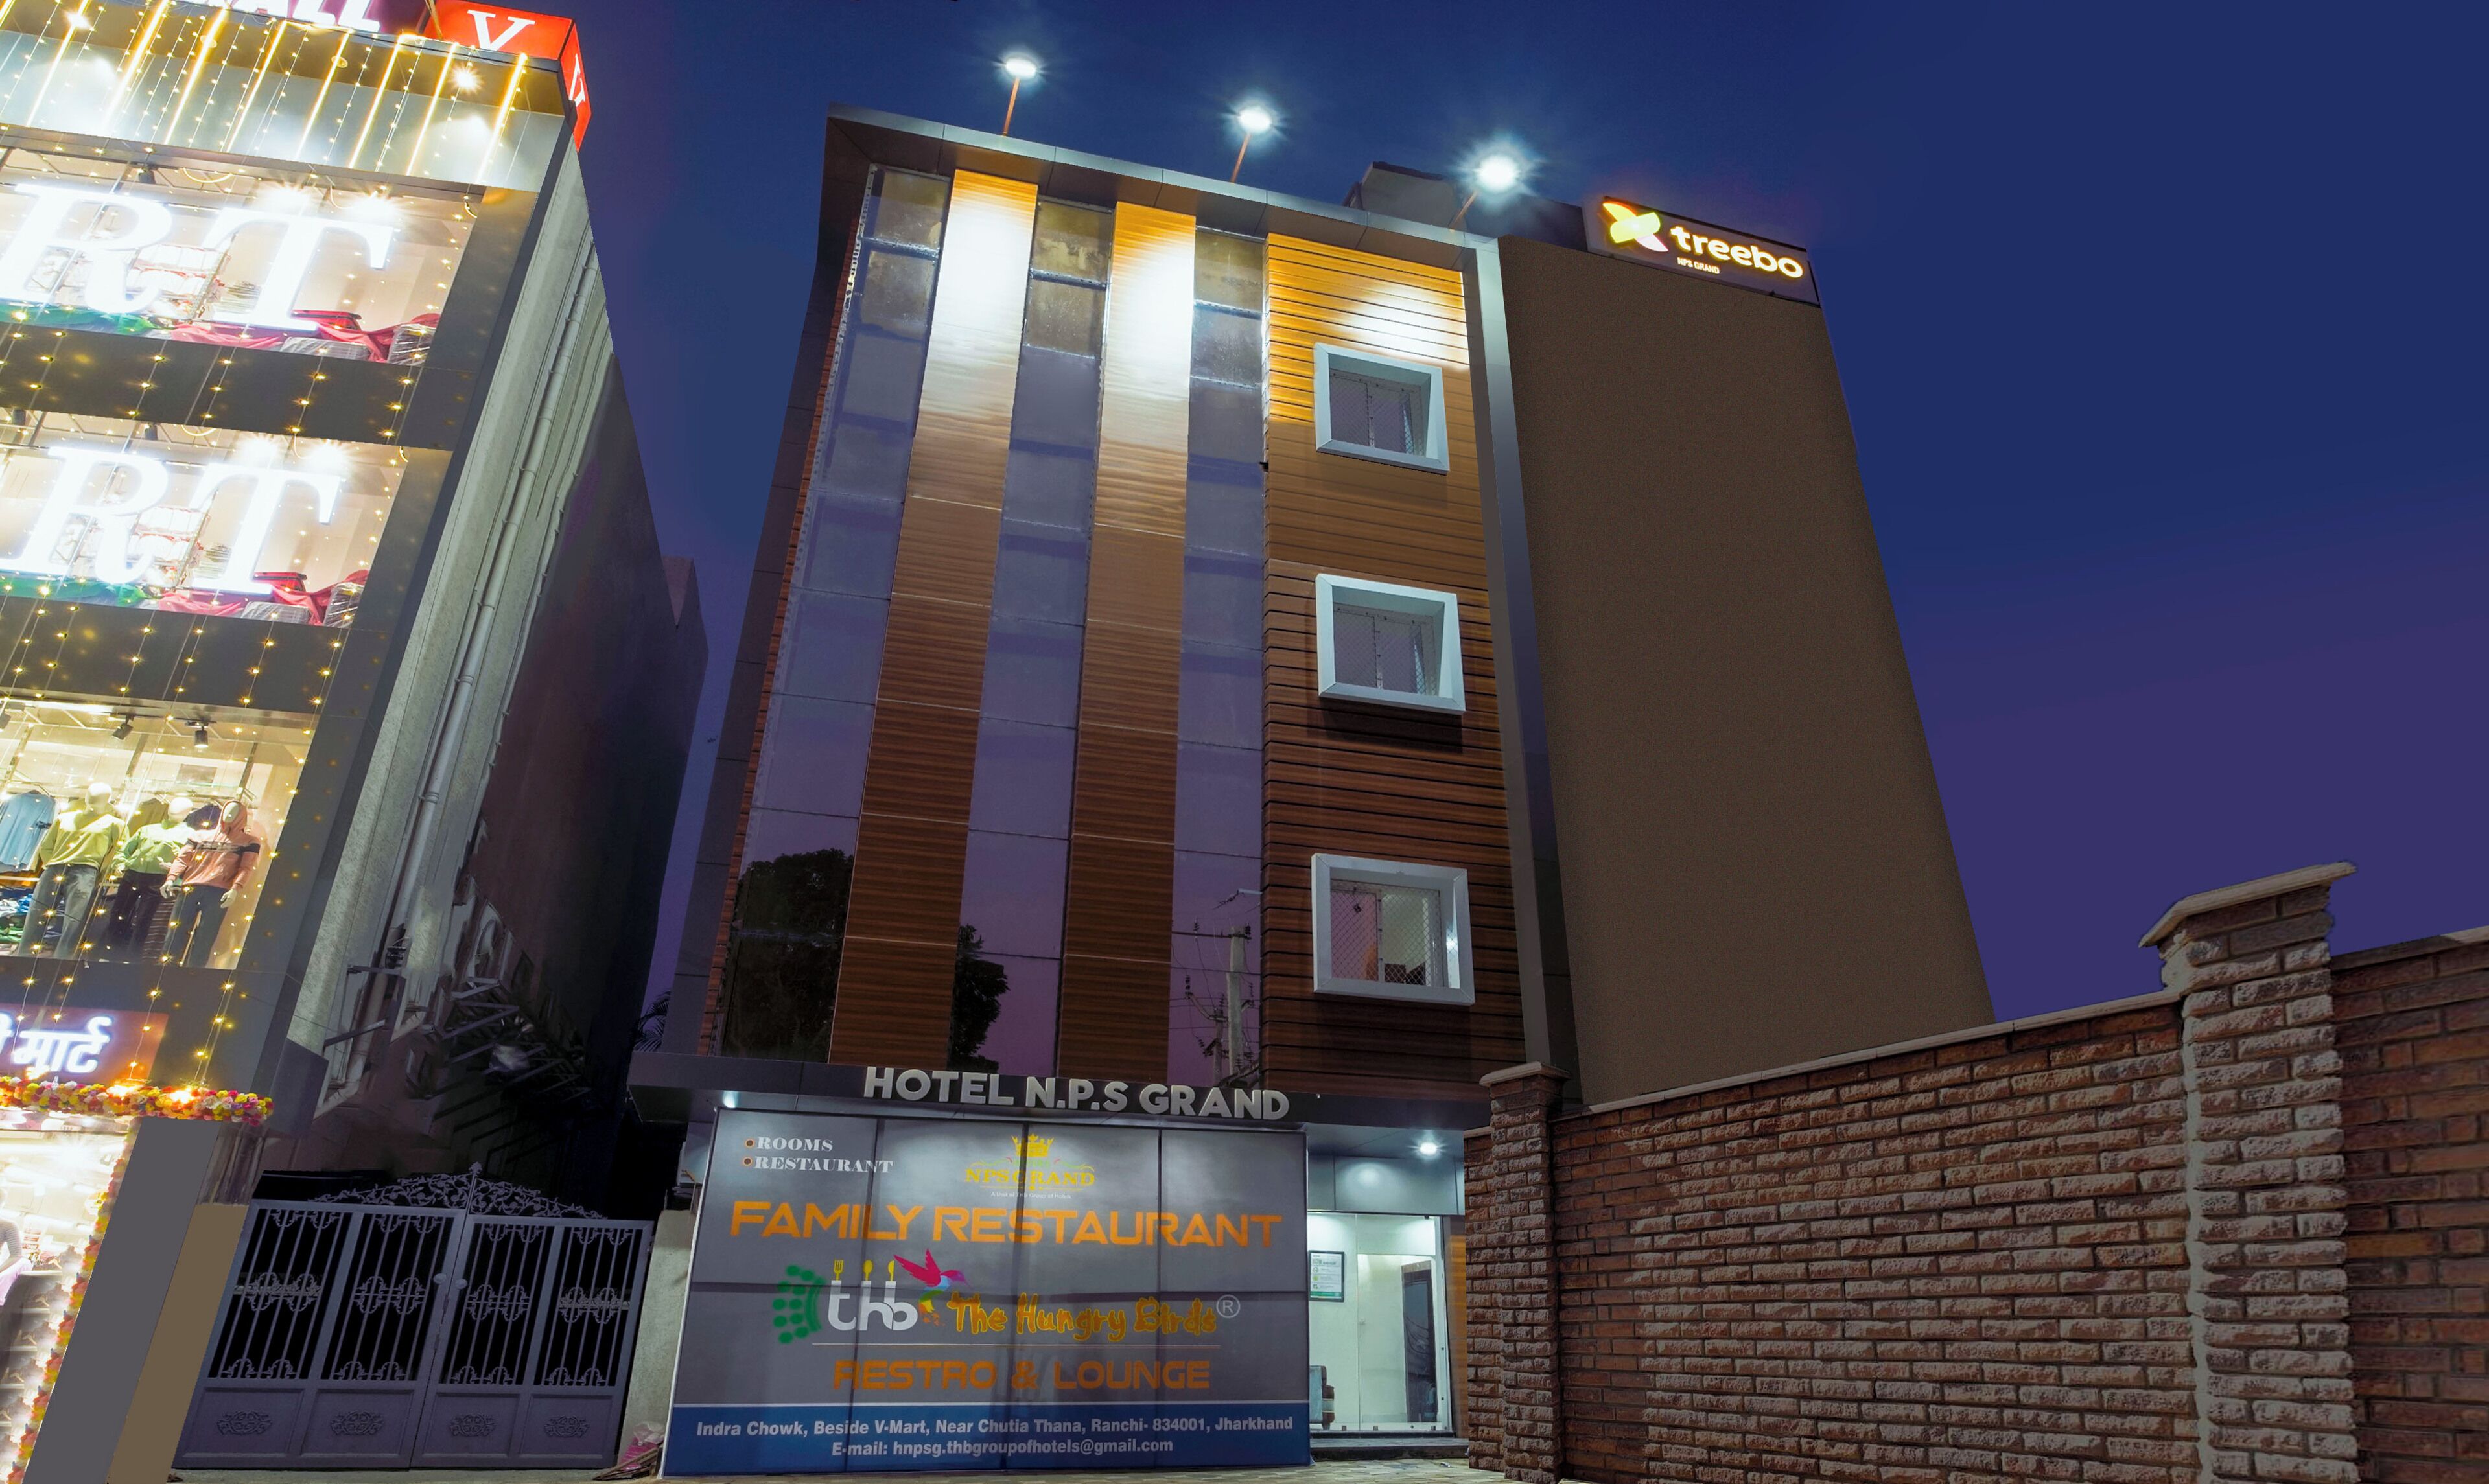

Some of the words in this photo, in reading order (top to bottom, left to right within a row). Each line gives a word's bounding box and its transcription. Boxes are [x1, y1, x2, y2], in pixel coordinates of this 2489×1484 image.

[467, 9, 535, 51] V
[1670, 226, 1803, 278] treebo
[1693, 261, 1720, 275] GRAND
[863, 1066, 1014, 1106] HOTEL
[1025, 1076, 1128, 1111] N.P.S
[1139, 1084, 1290, 1120] GRAND
[757, 1137, 833, 1152] ROOMS
[755, 1155, 893, 1173] RESTAURANT
[964, 1168, 1009, 1183] NPS
[1012, 1170, 1095, 1187] GRAND
[730, 1200, 924, 1240] FAMILY
[933, 1207, 1283, 1248] RESTAURANT
[947, 1290, 1009, 1334] The
[1016, 1292, 1127, 1341] Hungry
[1134, 1296, 1217, 1336] Birds
[833, 1360, 998, 1390] RESTRO
[1011, 1361, 1038, 1389] &
[1054, 1361, 1211, 1389] LOUNGE
[696, 1421, 741, 1435] Indra
[747, 1421, 808, 1437] Chowk,
[813, 1420, 869, 1434] Beside
[874, 1419, 930, 1436] V-Mart,
[935, 1419, 973, 1433] Near
[977, 1418, 1029, 1433] Chutia
[1034, 1419, 1086, 1435] Thana,
[1091, 1418, 1149, 1432] Ranchi-
[1152, 1417, 1210, 1432] 834001,
[1214, 1416, 1294, 1430] Jharkhand
[832, 1441, 888, 1455] E-mail:
[893, 1438, 1174, 1458] hnpsg.thbgroupofhotels@gmail.com
